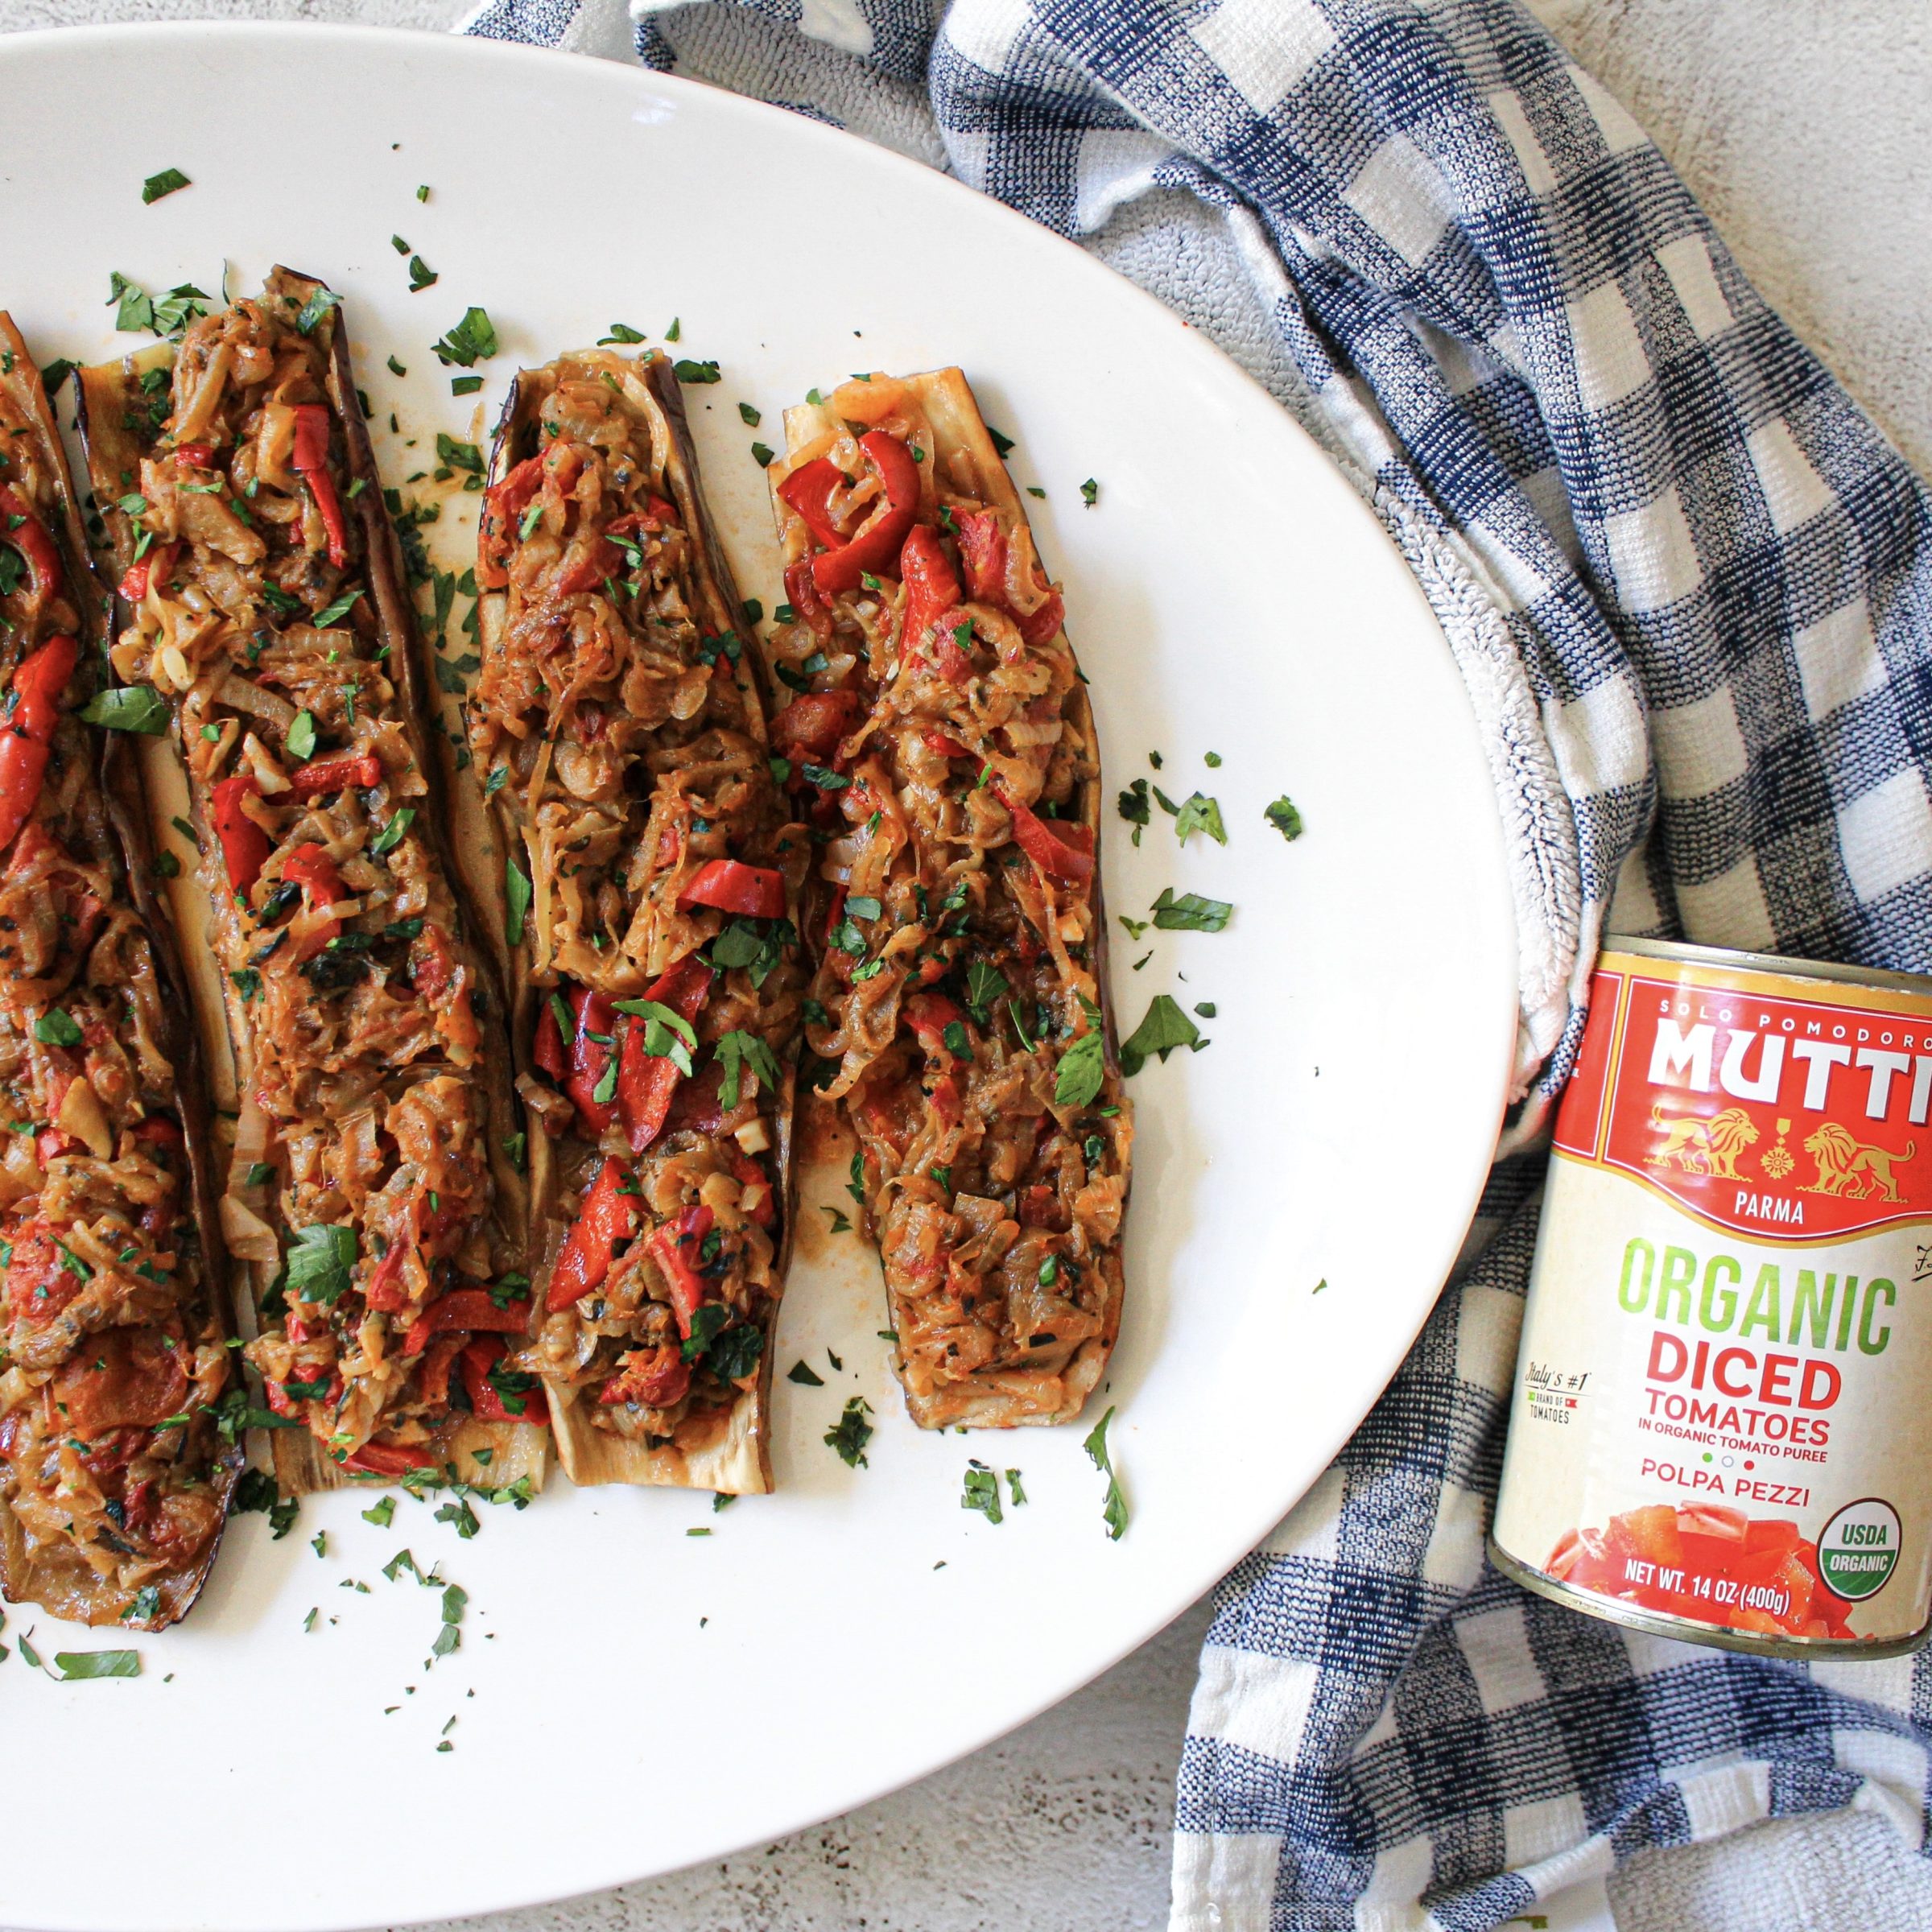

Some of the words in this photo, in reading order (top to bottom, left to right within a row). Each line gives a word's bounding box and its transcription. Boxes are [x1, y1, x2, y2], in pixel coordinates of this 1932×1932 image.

[1659, 999, 1732, 1022] SOLO
[1759, 1014, 1932, 1051] POMODORO
[1647, 1017, 1932, 1125] MUTTI
[1735, 1191, 1804, 1224] PARMA
[1617, 1237, 1896, 1356] ORGANIC
[1525, 1361, 1563, 1390] Italy's
[1646, 1331, 1841, 1410] DICED
[1530, 1404, 1570, 1425] TOMATOES
[1536, 1393, 1554, 1406] BRAND
[1555, 1396, 1563, 1406] OF
[1645, 1387, 1831, 1447] TOMATOES
[1638, 1417, 1651, 1430] IN
[1654, 1422, 1717, 1446] ORGANIC
[1719, 1435, 1780, 1457] TOMATO
[1783, 1447, 1828, 1463] PUREE
[1641, 1458, 1725, 1495] POLPA
[1734, 1478, 1810, 1508] PEZZI
[1842, 1524, 1888, 1546] USDA
[1624, 1558, 1655, 1585] NET
[1658, 1567, 1686, 1596] WT.
[1692, 1575, 1711, 1599] 14
[1715, 1580, 1736, 1605] OZ
[1740, 1583, 1791, 1617] (400g)
[1830, 1554, 1889, 1573] ORGANIC
